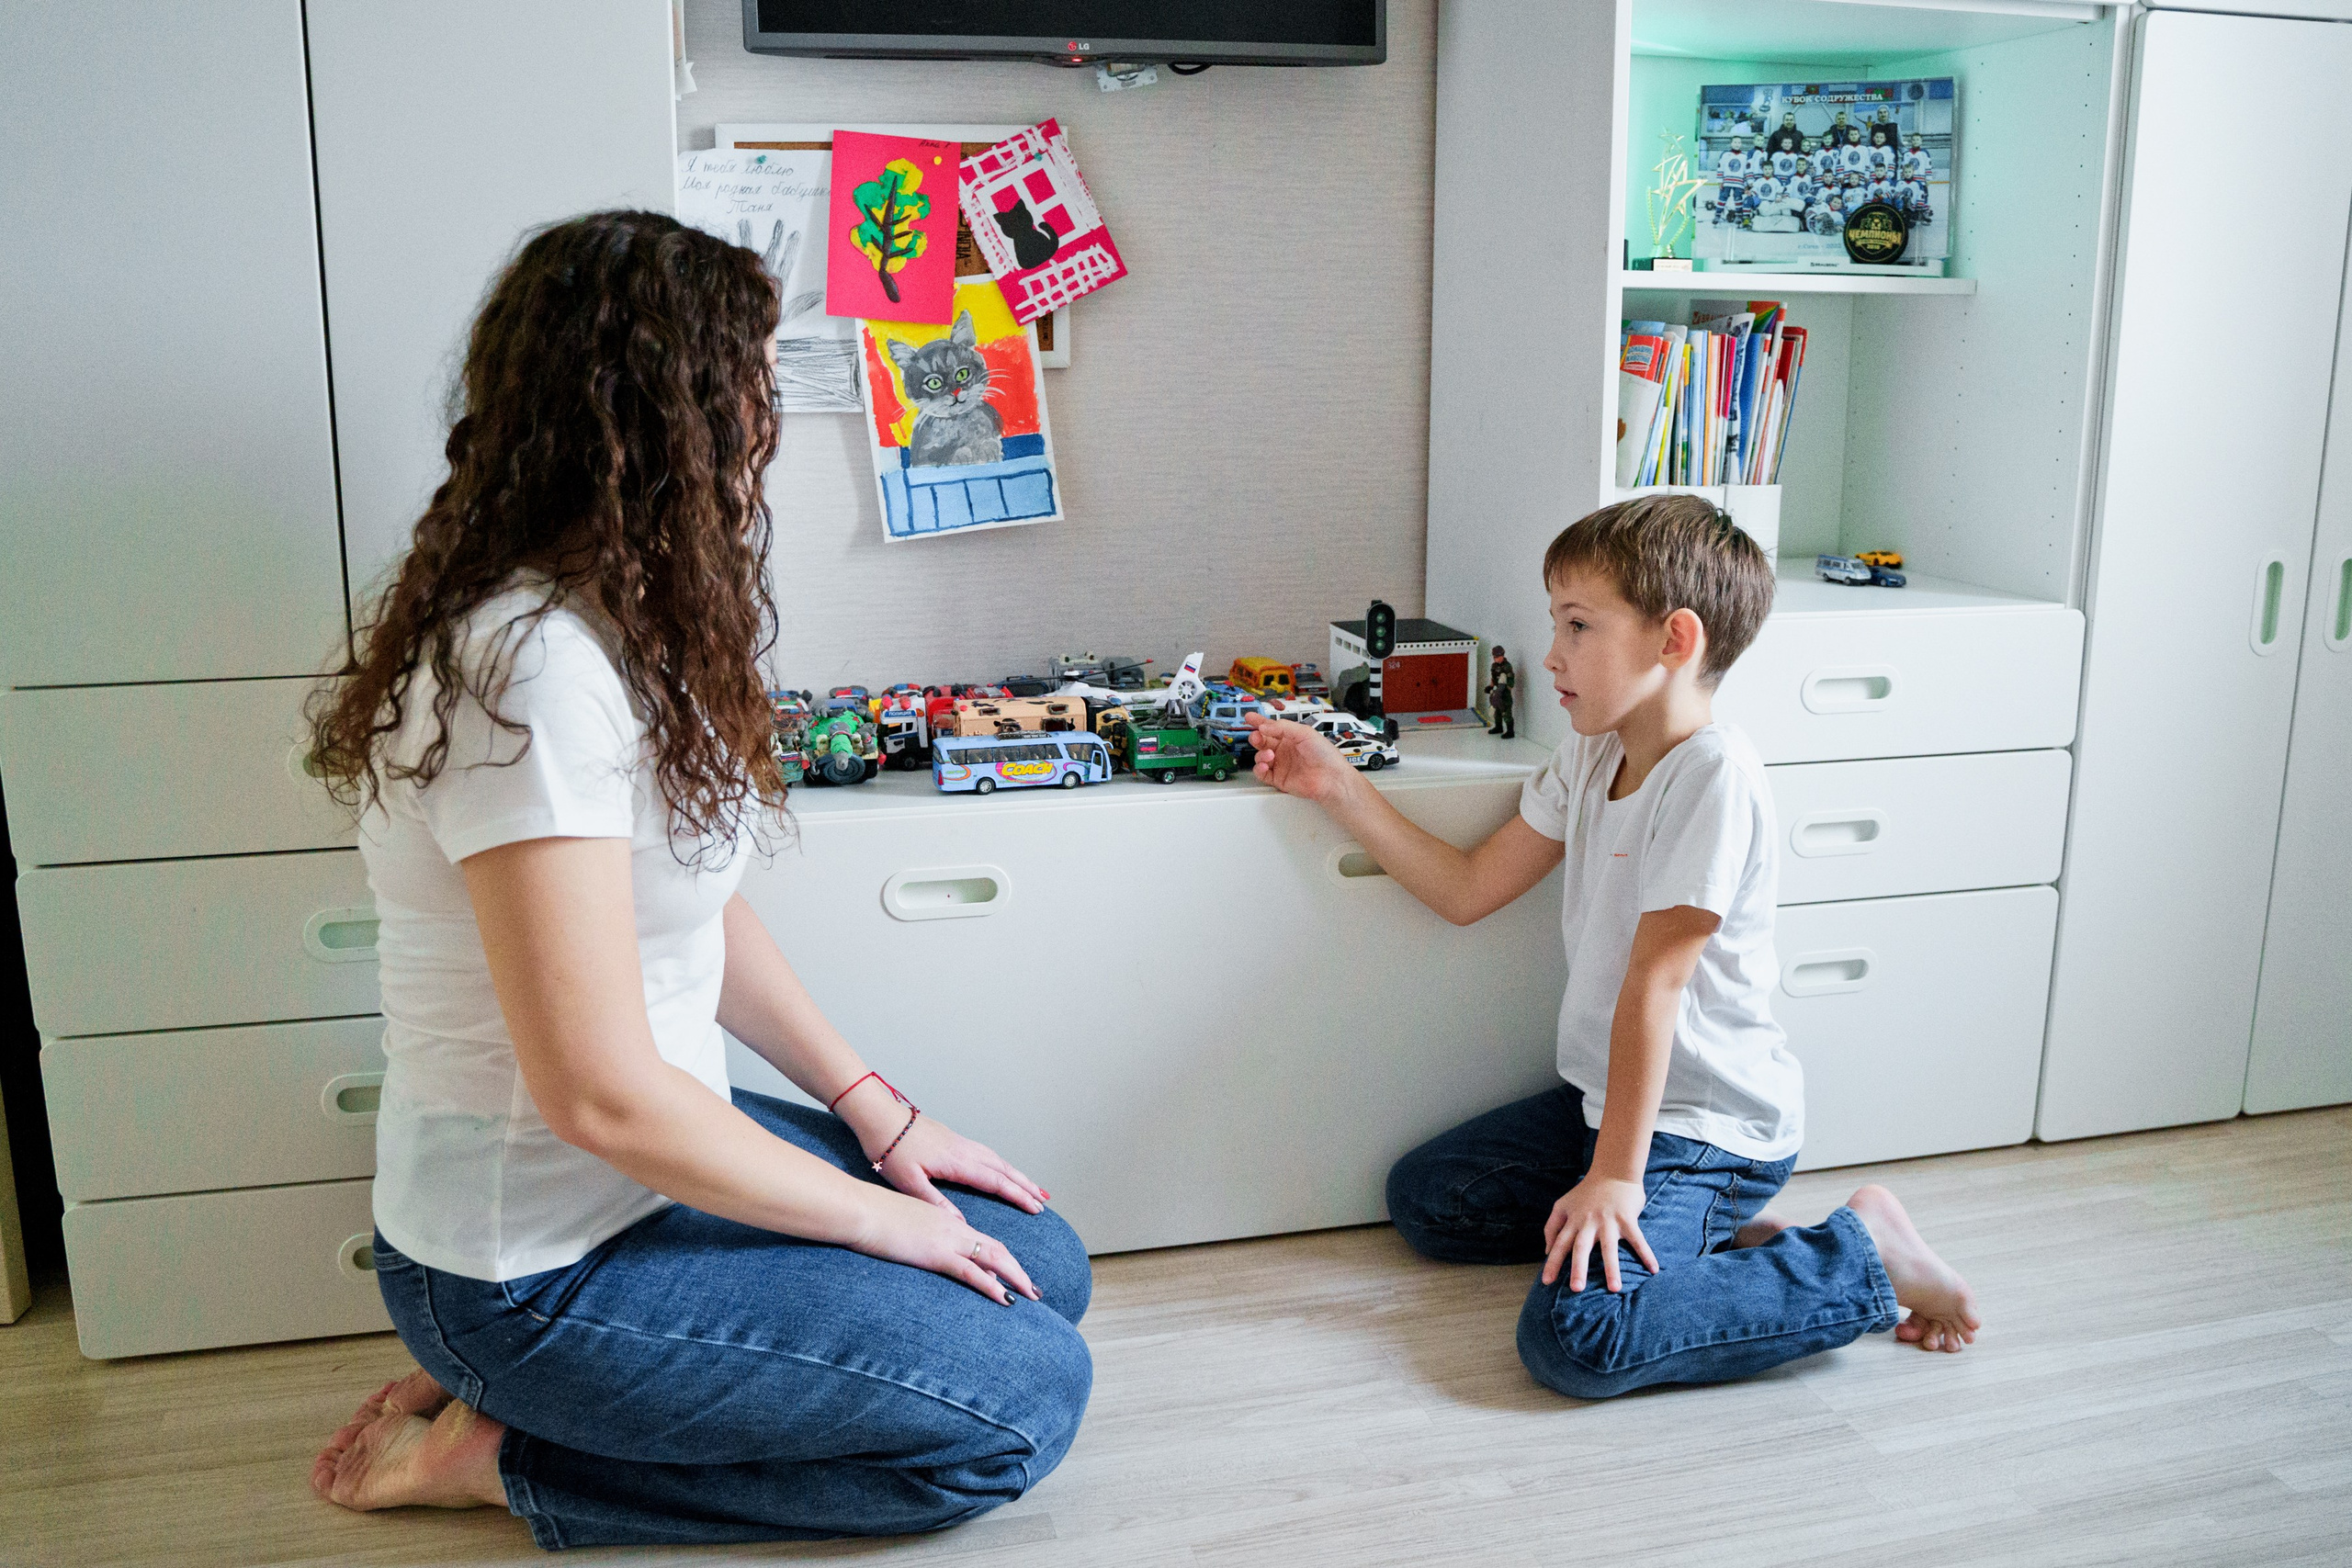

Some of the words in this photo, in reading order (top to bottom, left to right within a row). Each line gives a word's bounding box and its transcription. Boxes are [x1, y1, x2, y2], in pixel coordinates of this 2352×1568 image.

[1079, 42, 1090, 51] LG
[1781, 95, 1812, 103] КУБОК
[1814, 93, 1883, 102] СОДРУЖЕСТВА
[681, 156, 698, 173] Я
[703, 159, 737, 174] тебя
[741, 162, 795, 176] люблю
[678, 175, 711, 191] Моя
[714, 183, 763, 199] родная
[771, 181, 831, 202] бабушк
[726, 198, 774, 214] Таня
[1848, 229, 1903, 245] ЧЕМПИОНЫ
[1001, 761, 1054, 776] COACH
